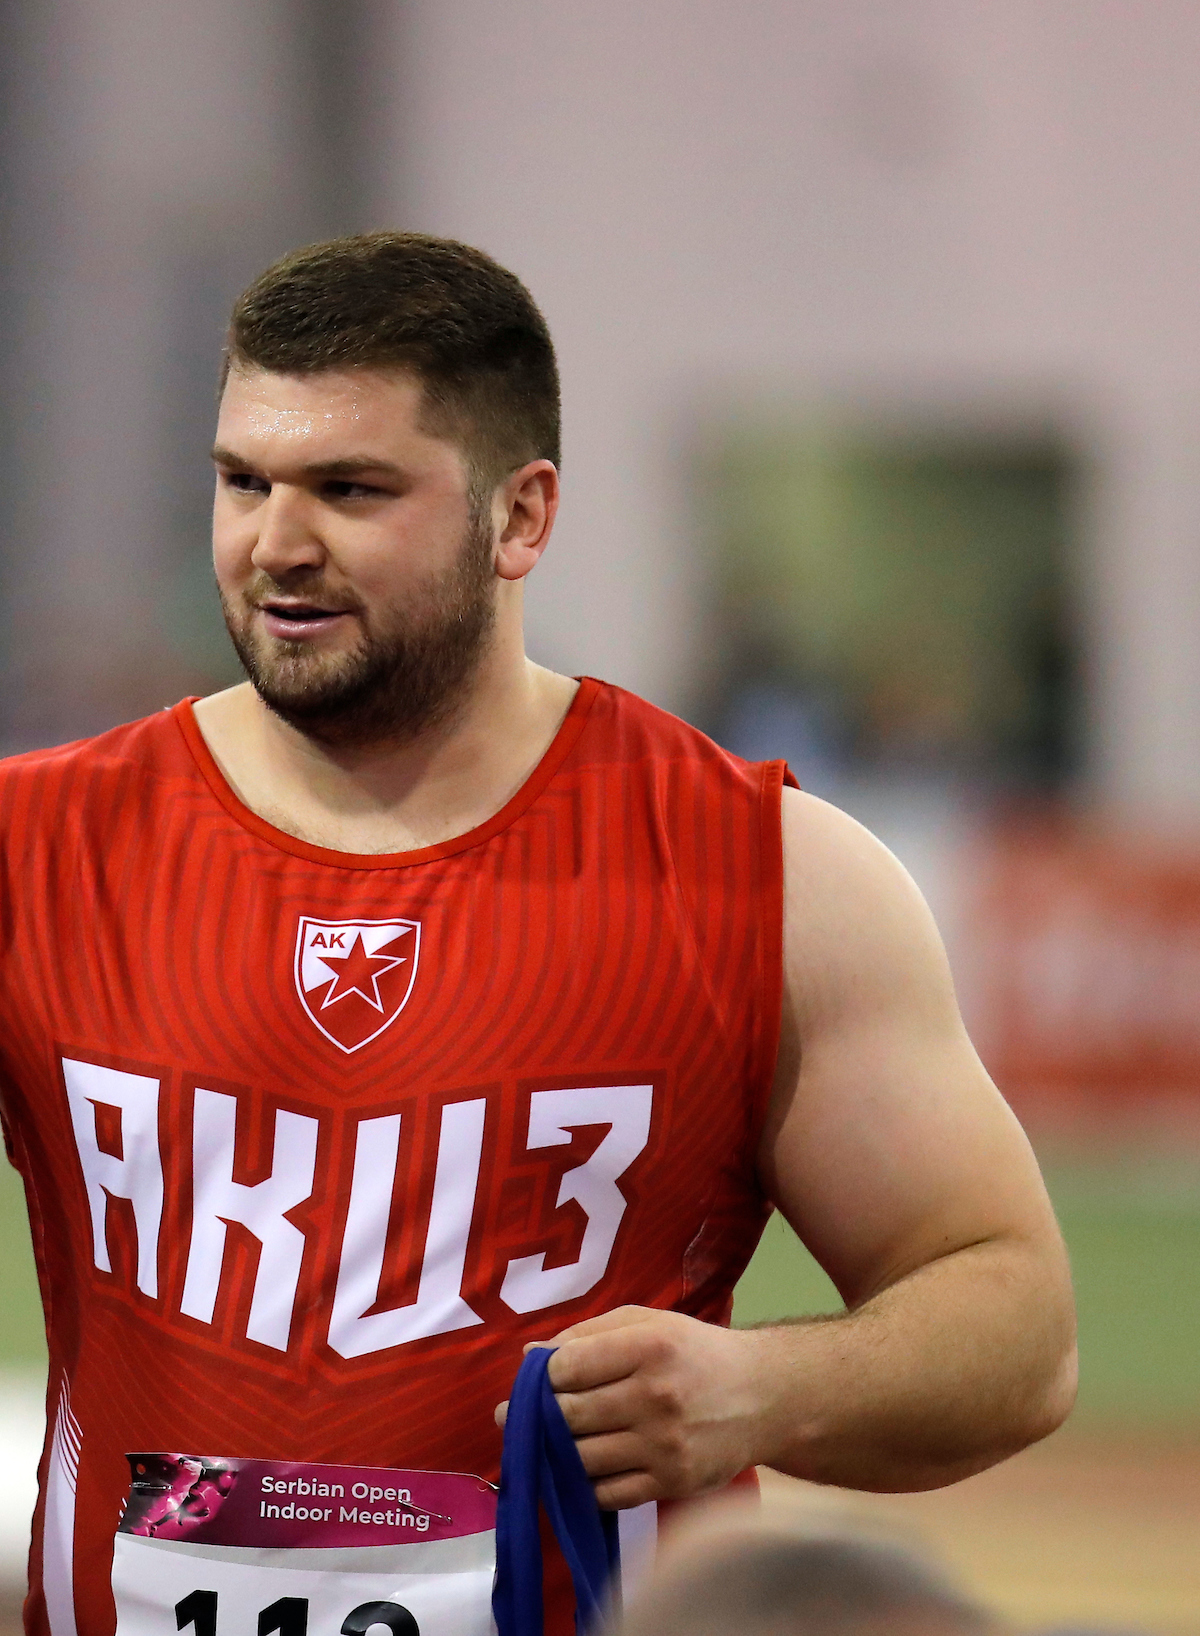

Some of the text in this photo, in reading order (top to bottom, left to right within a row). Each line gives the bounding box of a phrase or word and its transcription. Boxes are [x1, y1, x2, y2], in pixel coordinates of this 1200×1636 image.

[260, 1475, 411, 1503] Serbian Open
[259, 1500, 430, 1532] Indoor Meeting
